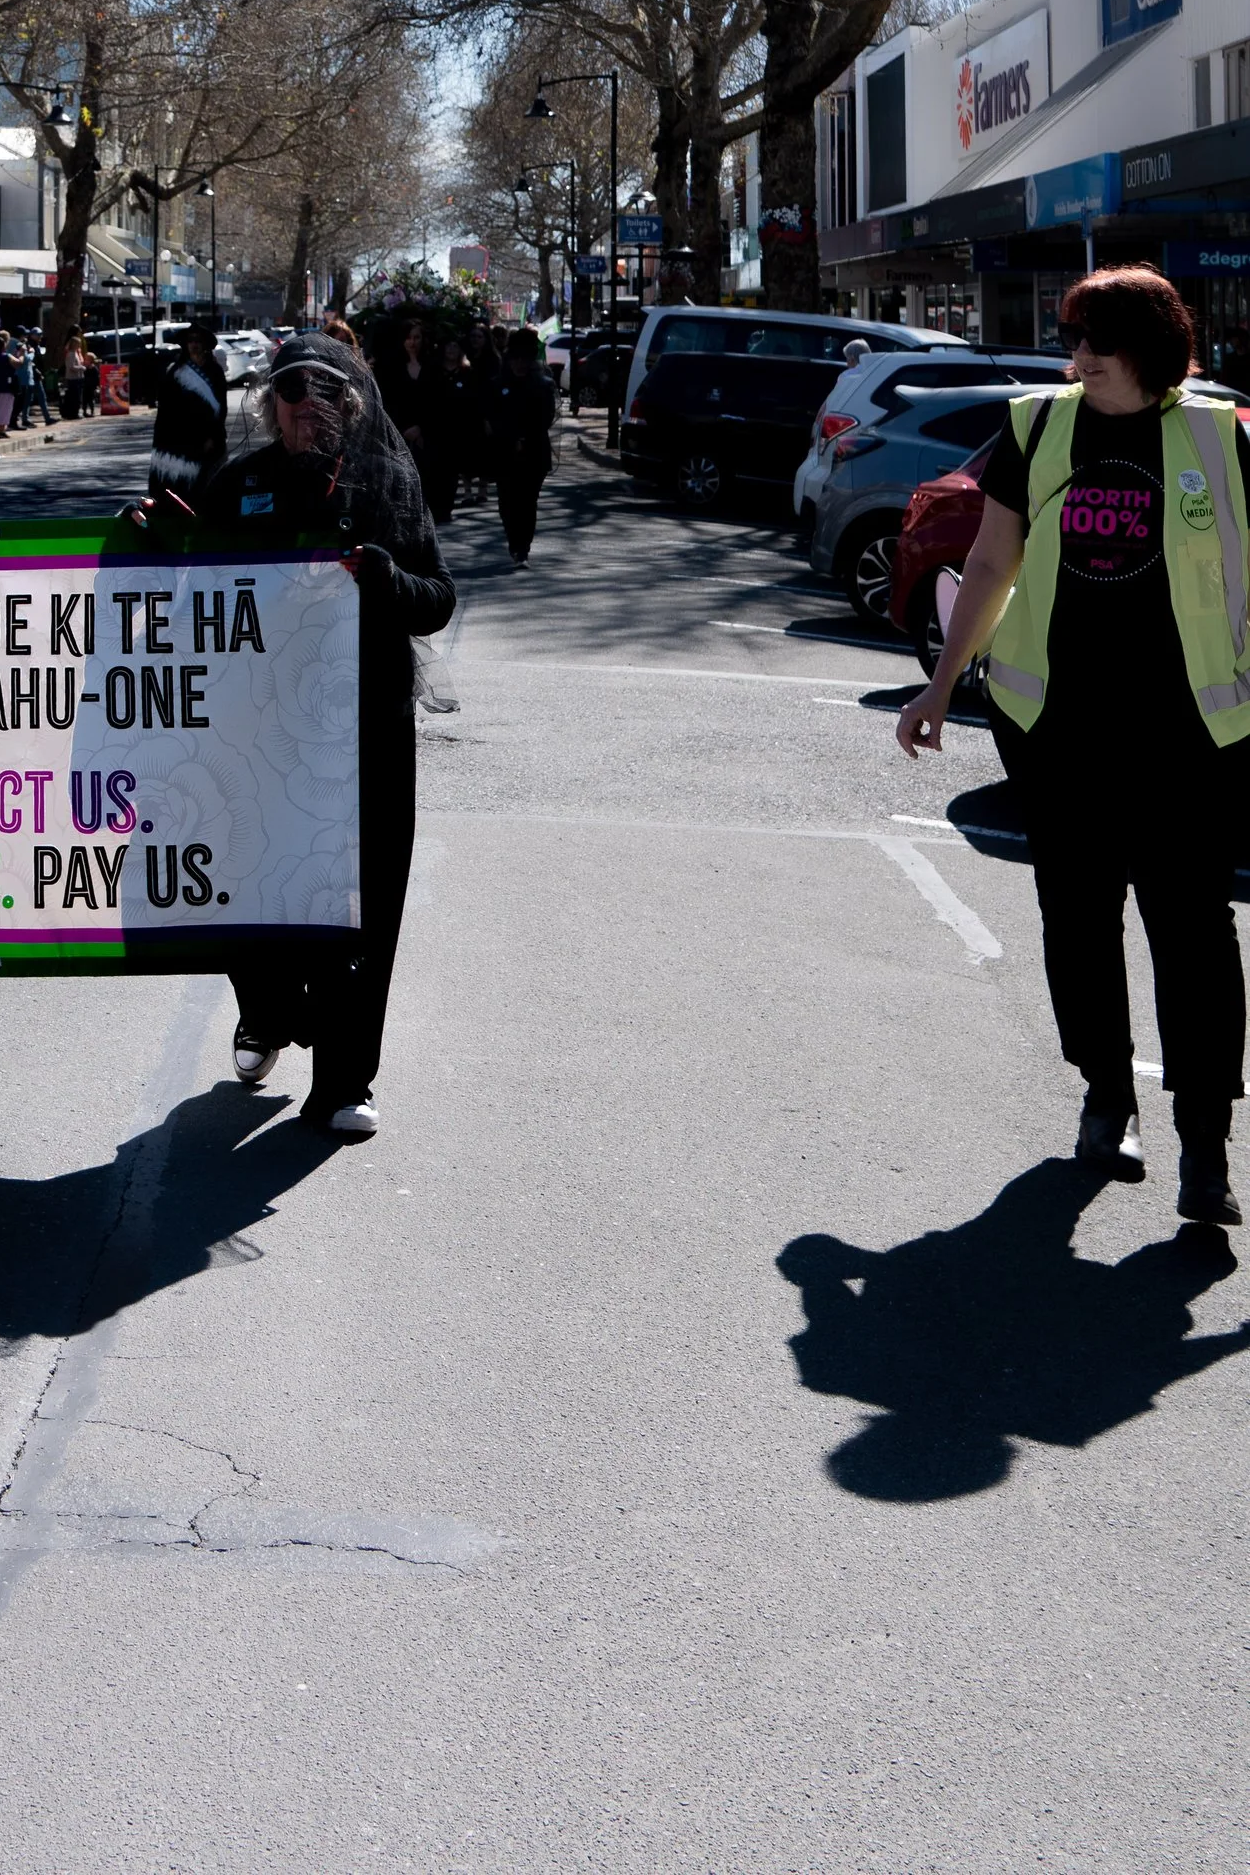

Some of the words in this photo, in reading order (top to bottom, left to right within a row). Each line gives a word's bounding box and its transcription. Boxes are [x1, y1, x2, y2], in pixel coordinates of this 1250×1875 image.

[973, 60, 1031, 135] Farmers
[1125, 156, 1157, 189] COTTON
[1158, 152, 1172, 182] ON
[1198, 249, 1250, 269] 2degr
[1065, 486, 1152, 509] WORTH
[1186, 508, 1214, 519] MEDIA
[1061, 506, 1150, 539] 100%
[1090, 559, 1115, 571] PSA
[50, 592, 96, 657] KI
[113, 590, 174, 655] TE
[193, 577, 266, 654] HĀ
[71, 769, 154, 835] US.
[33, 844, 130, 910] PAY
[147, 843, 231, 910] US.
